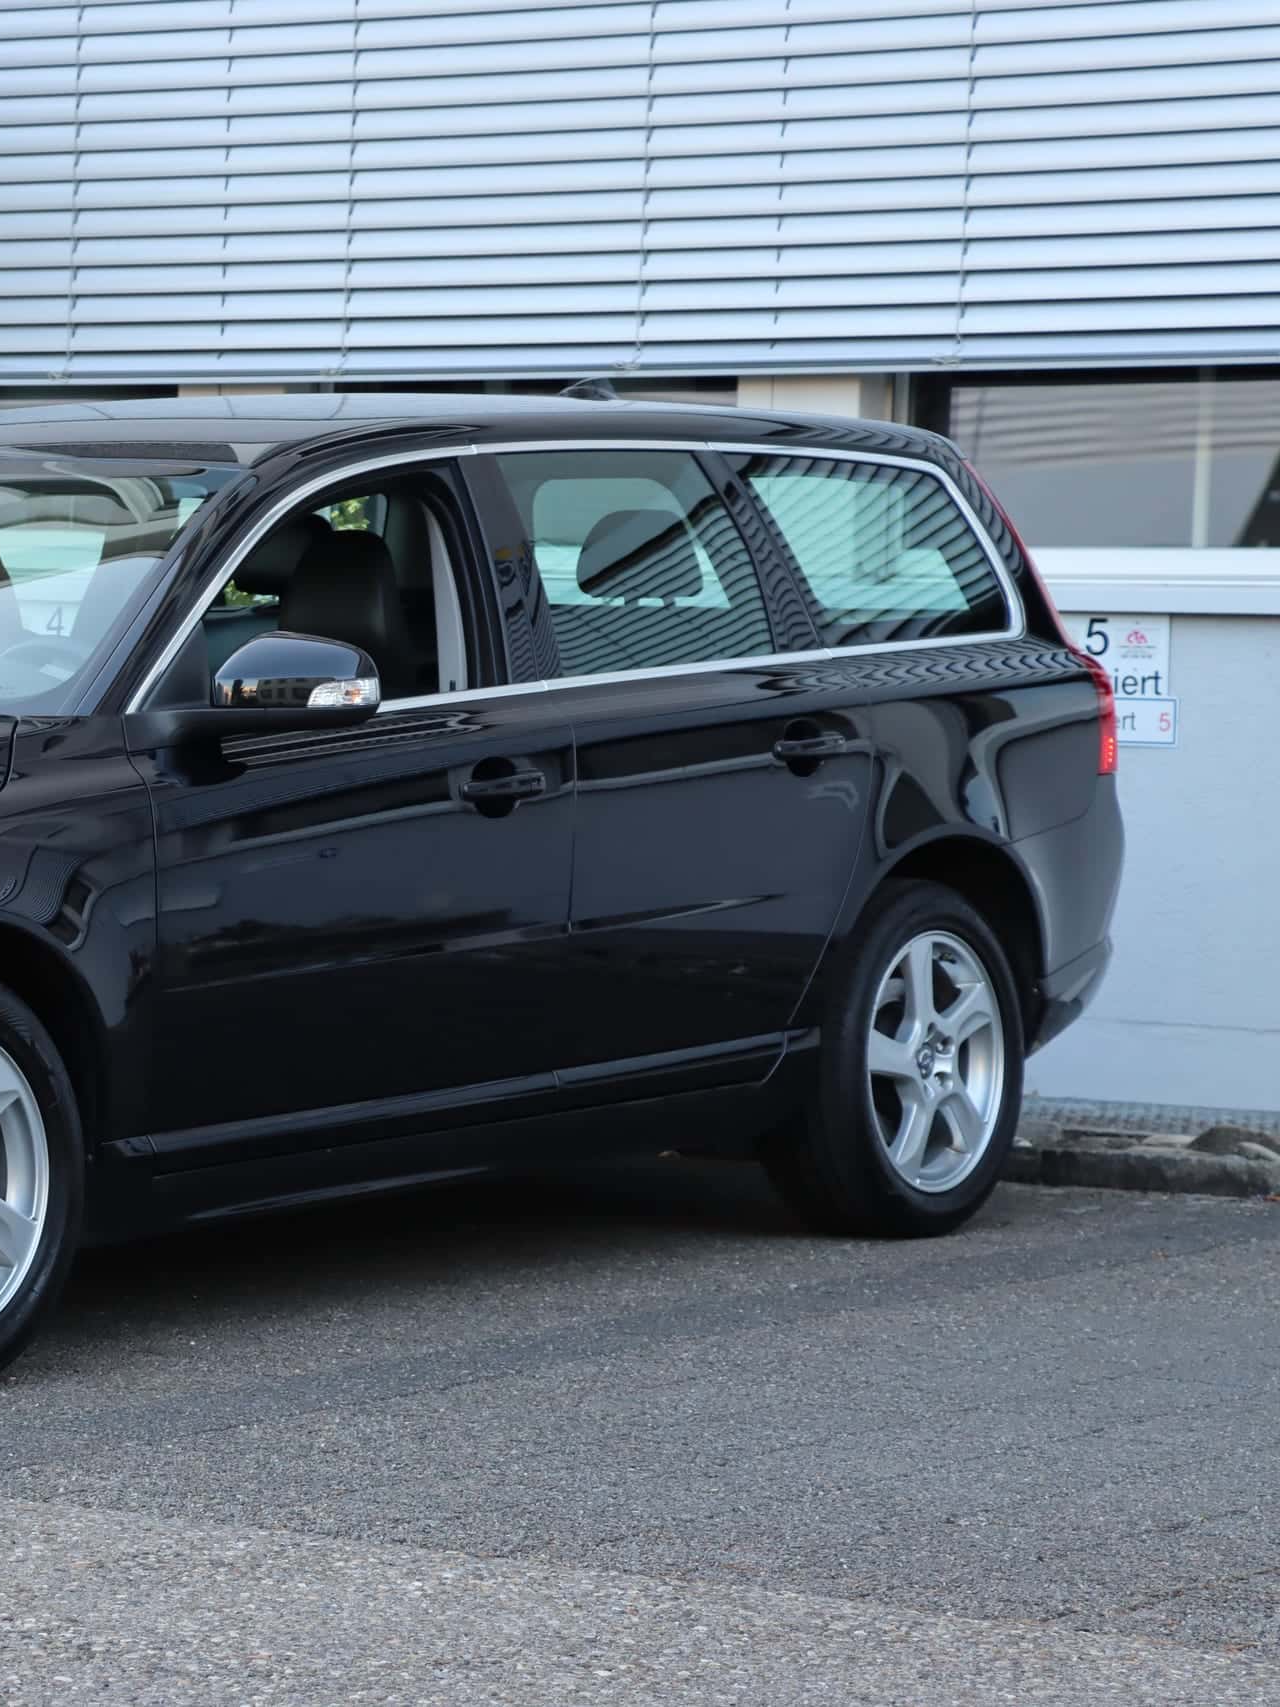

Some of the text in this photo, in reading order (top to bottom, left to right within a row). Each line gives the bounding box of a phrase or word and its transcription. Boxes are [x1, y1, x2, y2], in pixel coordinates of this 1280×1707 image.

[46, 605, 65, 637] 4
[1086, 618, 1109, 655] 5
[1114, 668, 1162, 696] iert
[1116, 711, 1171, 732] rt 5
